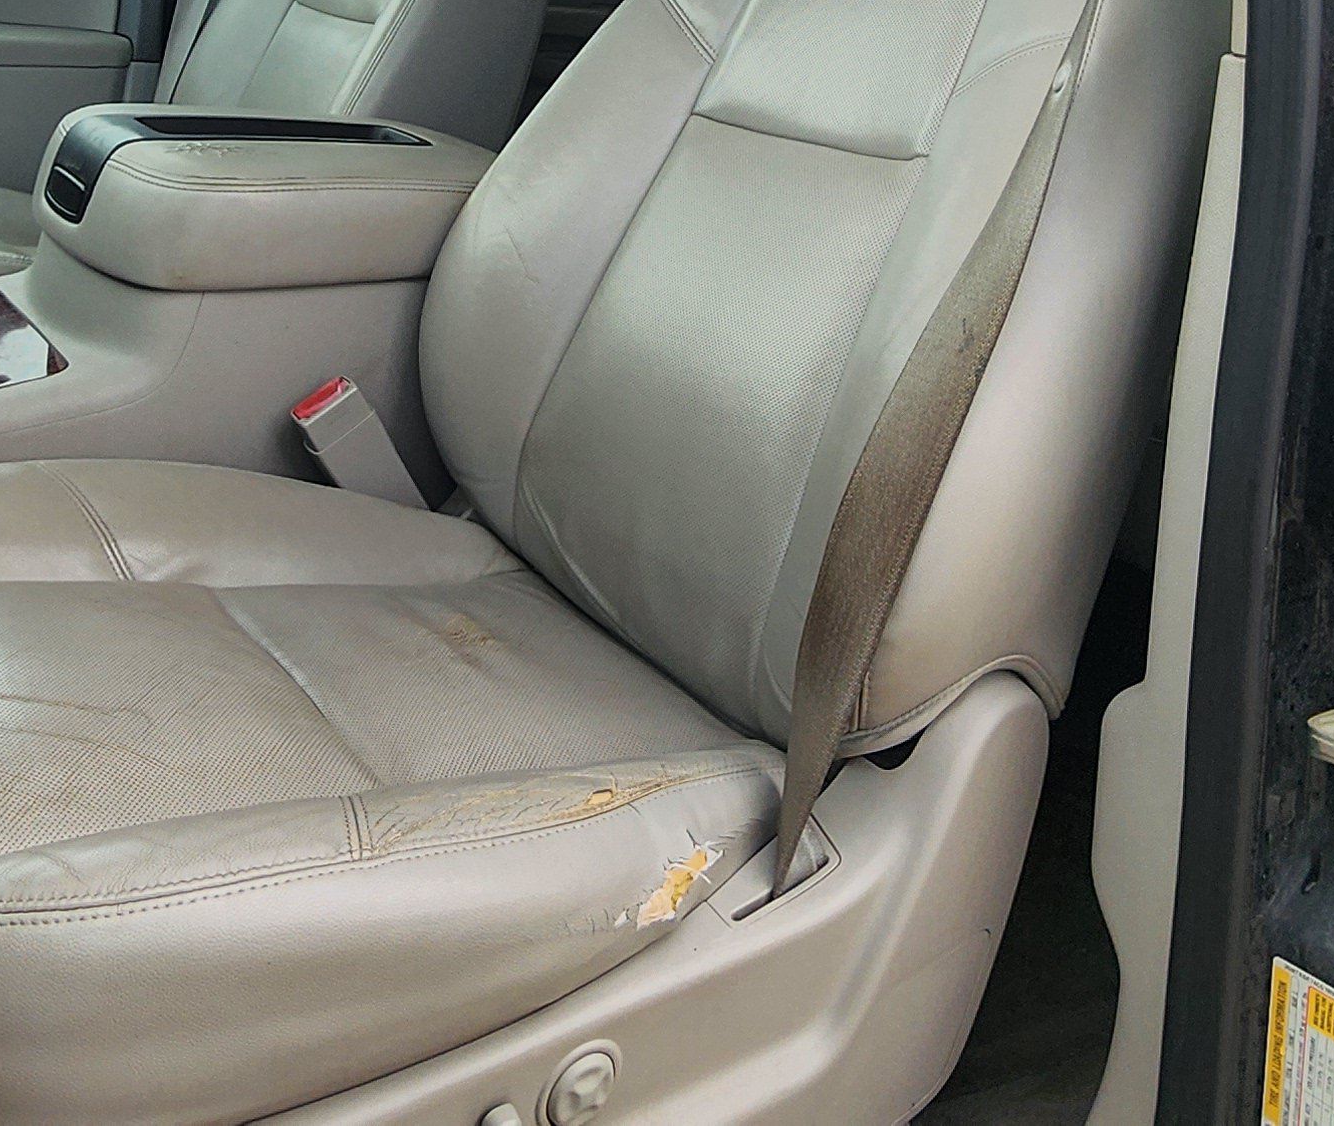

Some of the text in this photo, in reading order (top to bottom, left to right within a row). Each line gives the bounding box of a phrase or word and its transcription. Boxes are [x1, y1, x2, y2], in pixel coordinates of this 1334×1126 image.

[1269, 980, 1286, 1108] TIRE AND LOADING INFORMATION
